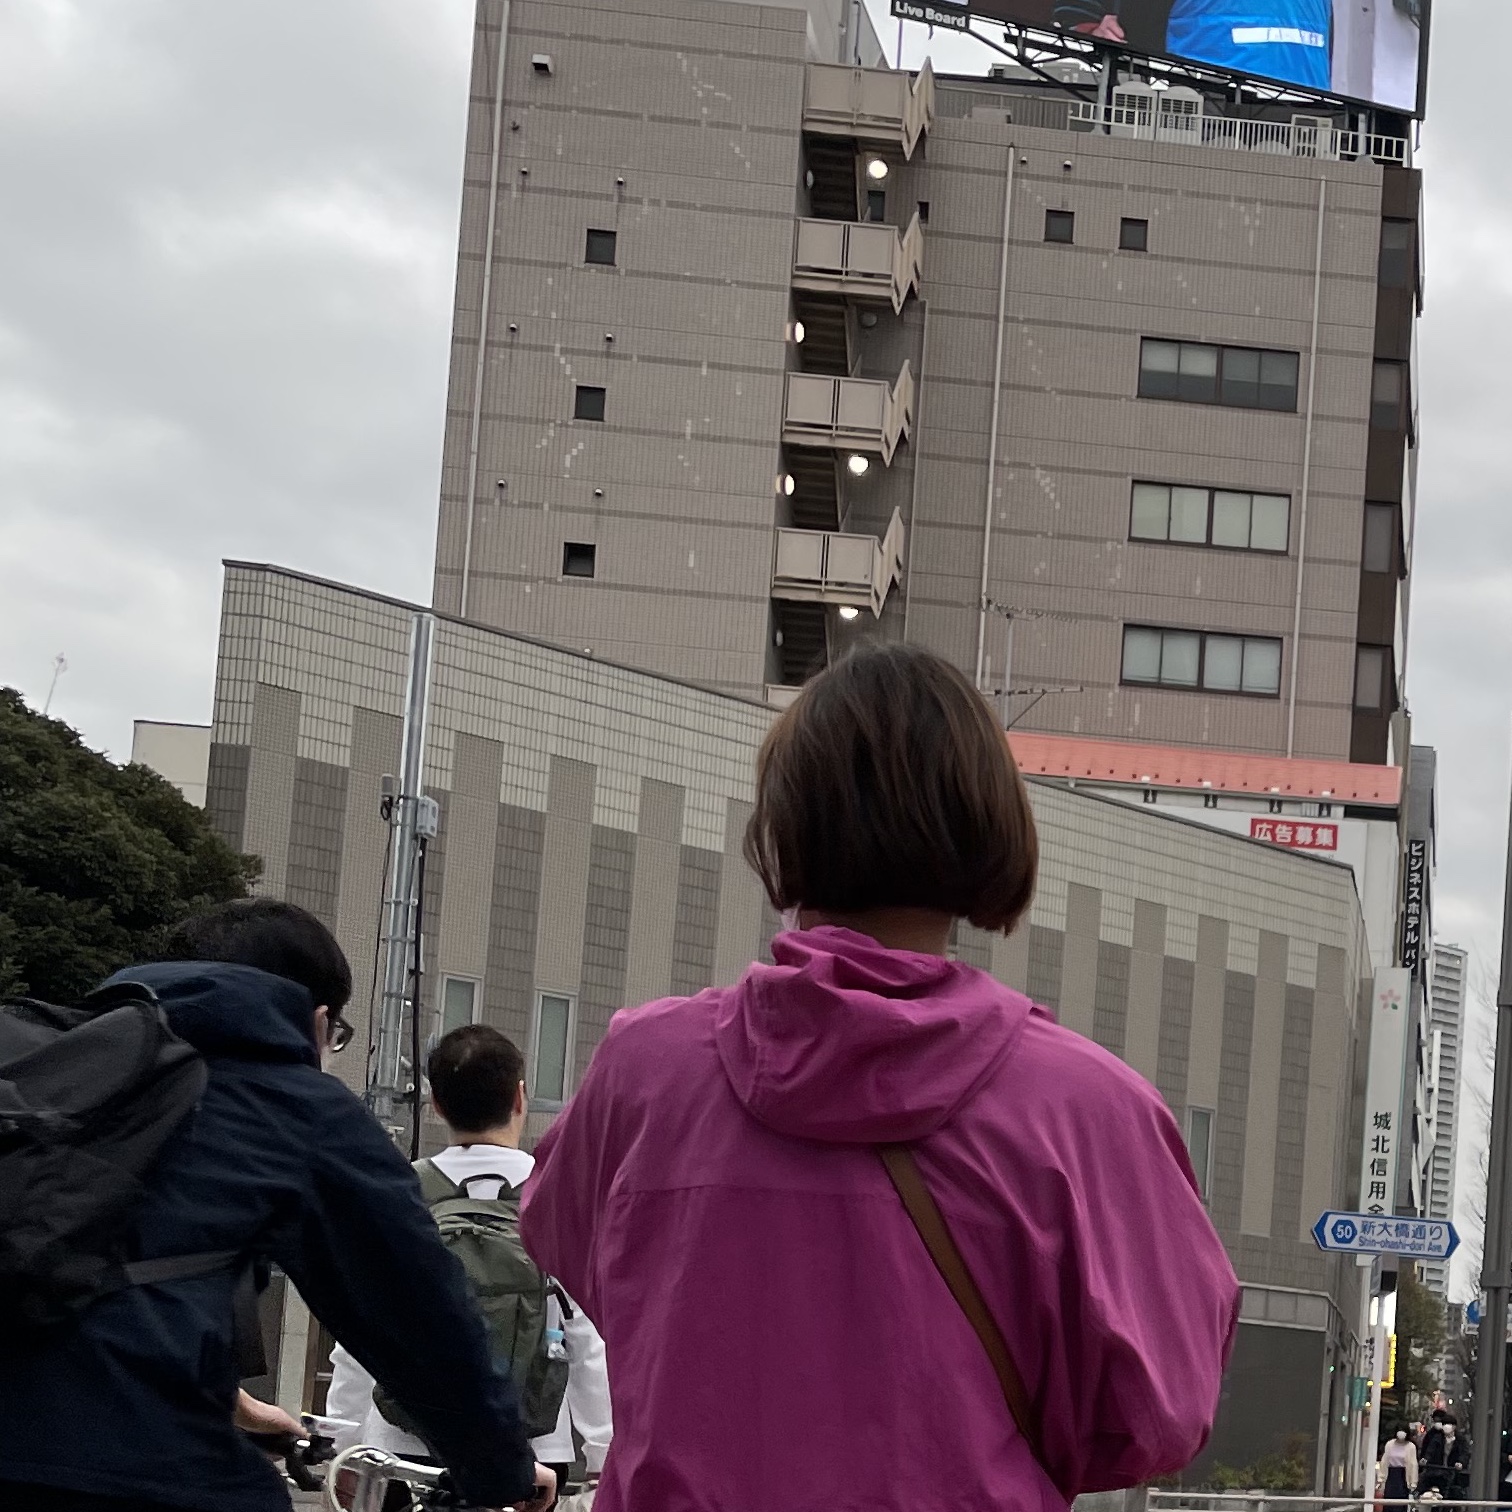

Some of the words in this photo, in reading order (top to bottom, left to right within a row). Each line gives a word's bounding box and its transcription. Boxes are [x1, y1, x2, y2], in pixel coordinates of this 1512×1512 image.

[895, 0, 924, 18] Live
[925, 7, 966, 28] Board
[1254, 822, 1334, 847] 広告募集
[1336, 1224, 1353, 1239] 50
[1360, 1220, 1443, 1241] 新大橋通り
